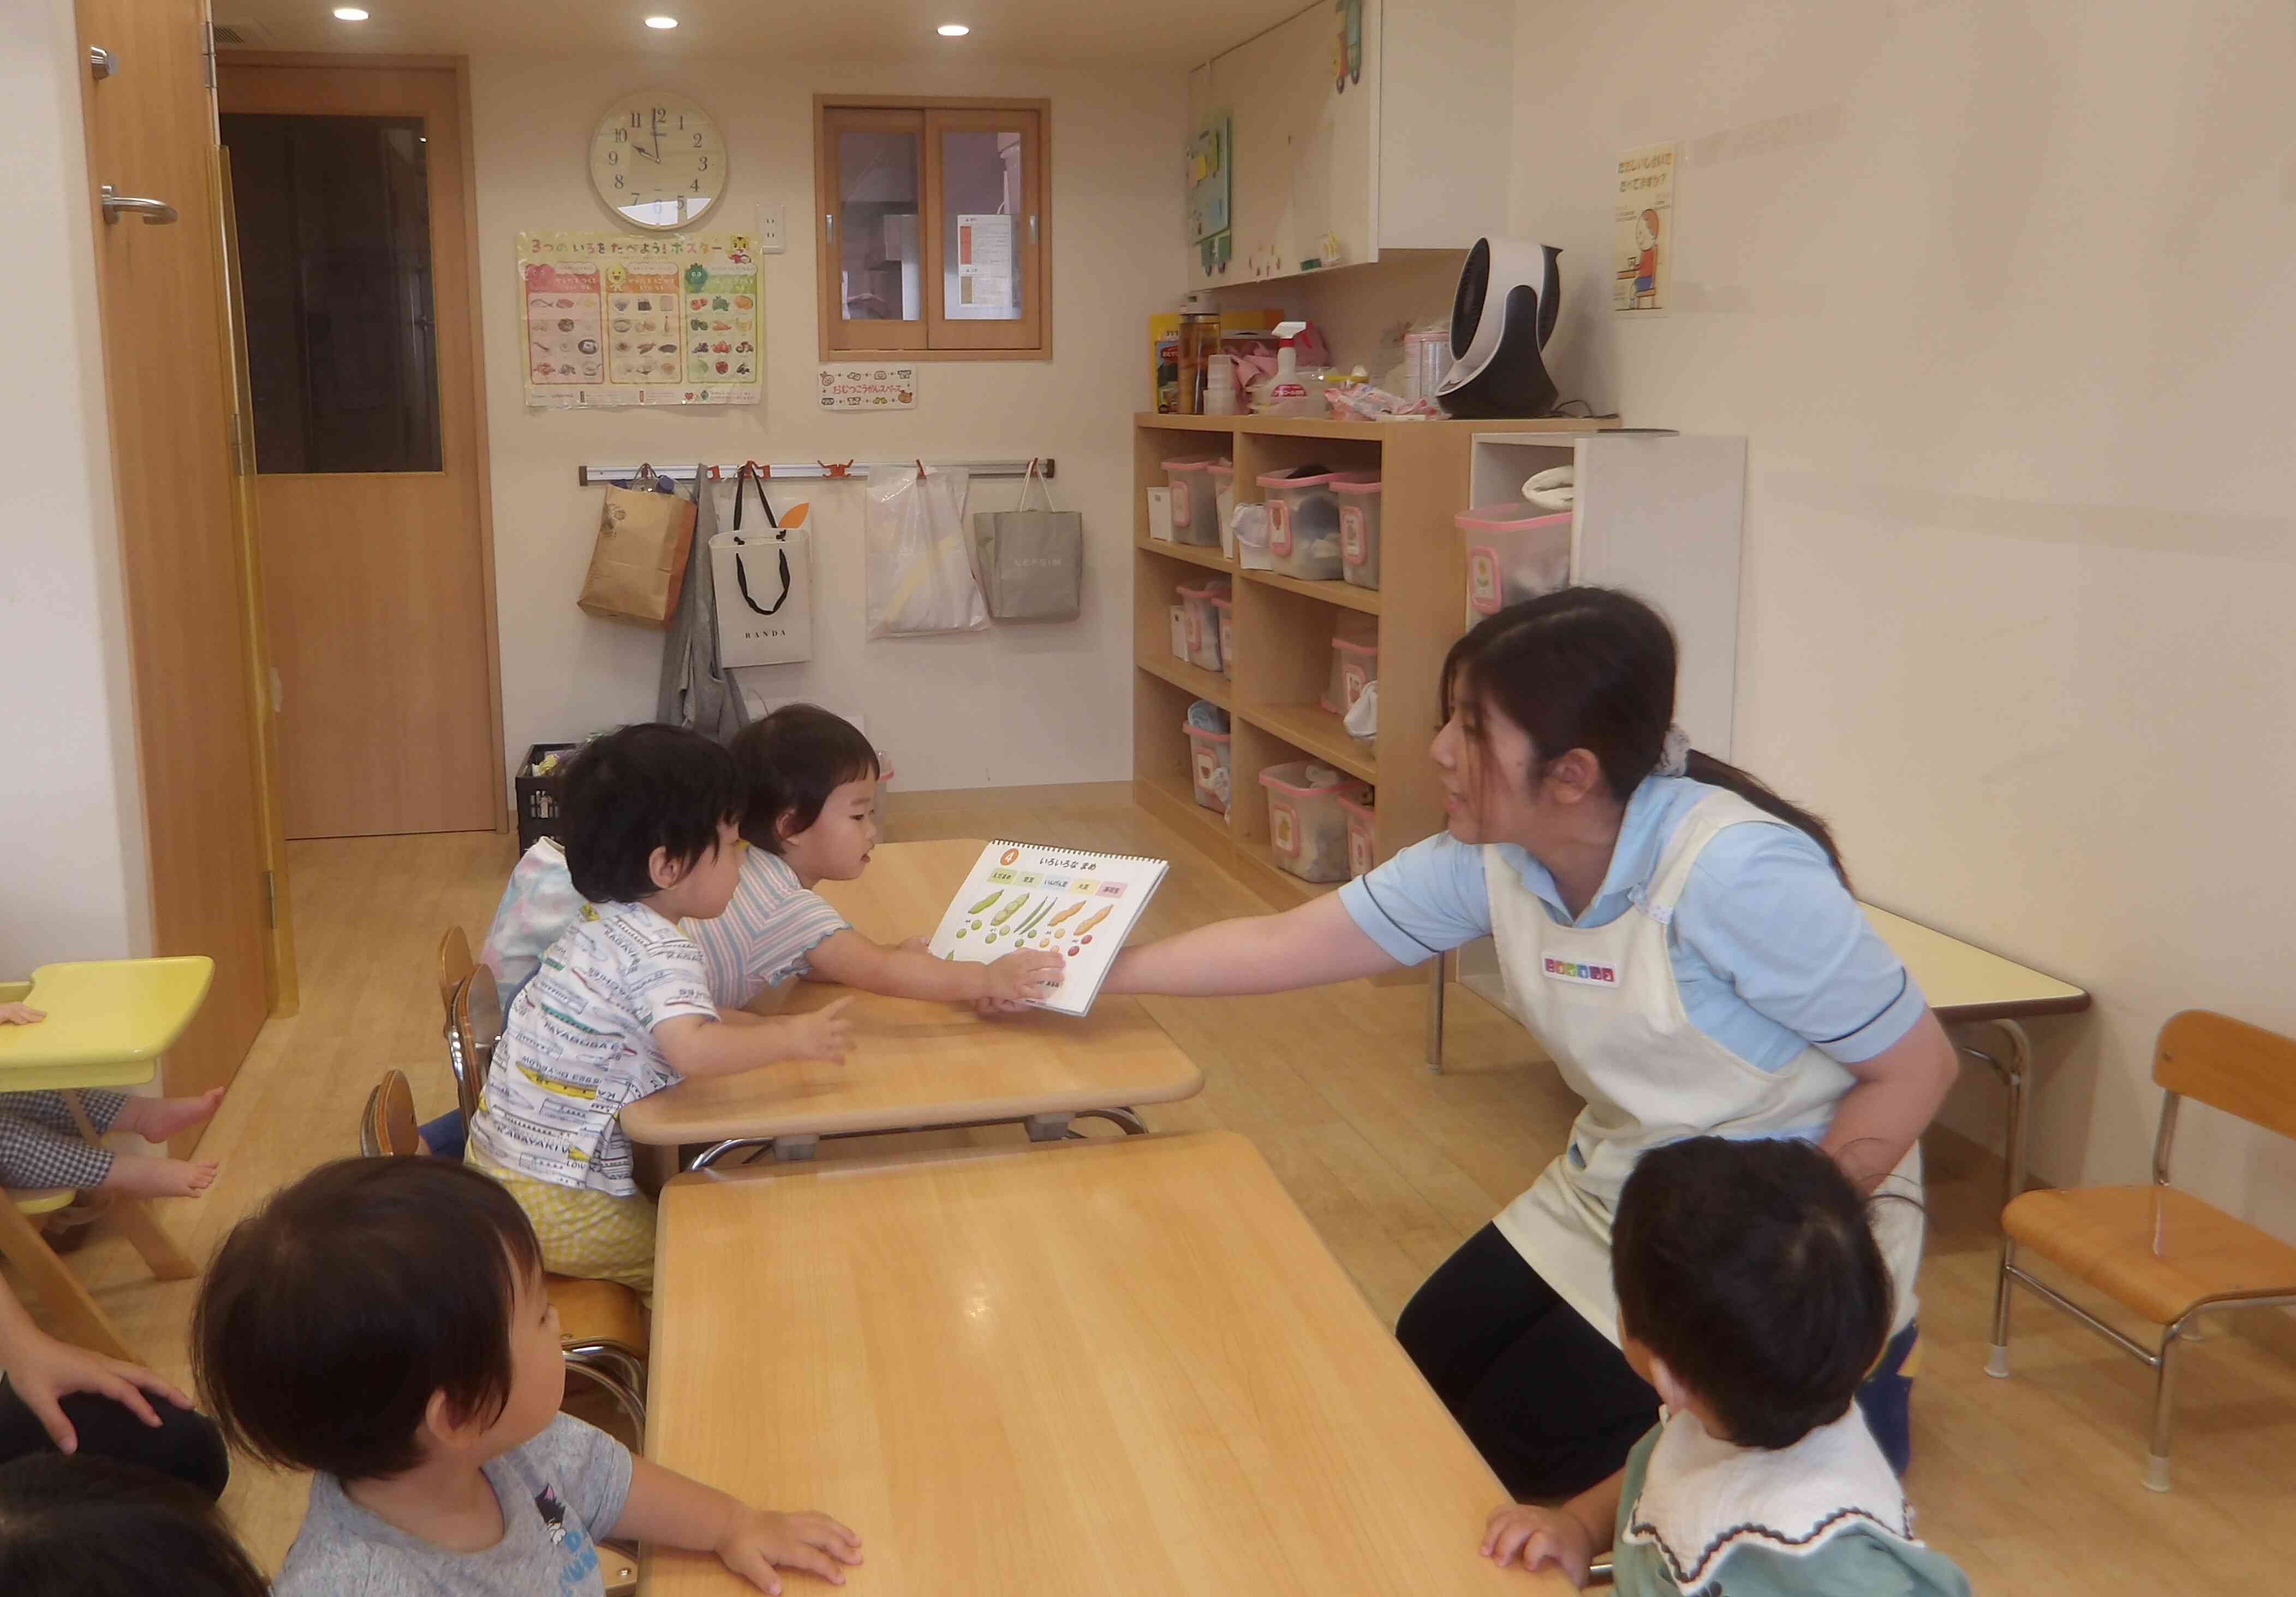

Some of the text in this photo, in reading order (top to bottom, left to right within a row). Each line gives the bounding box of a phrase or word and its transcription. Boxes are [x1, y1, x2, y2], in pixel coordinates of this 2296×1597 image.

[630, 112, 641, 128] 11
[652, 108, 667, 123] 12
[678, 115, 684, 130] 1
[613, 128, 628, 143] 10
[693, 133, 702, 148] 2
[609, 151, 618, 166] 9
[698, 156, 708, 172] 3
[614, 174, 624, 189] 8
[689, 178, 700, 192] 4
[631, 192, 640, 206] 7
[677, 195, 685, 210] 5
[833, 384, 903, 394] おむつこうかんスペース
[744, 630, 786, 639] RANDA
